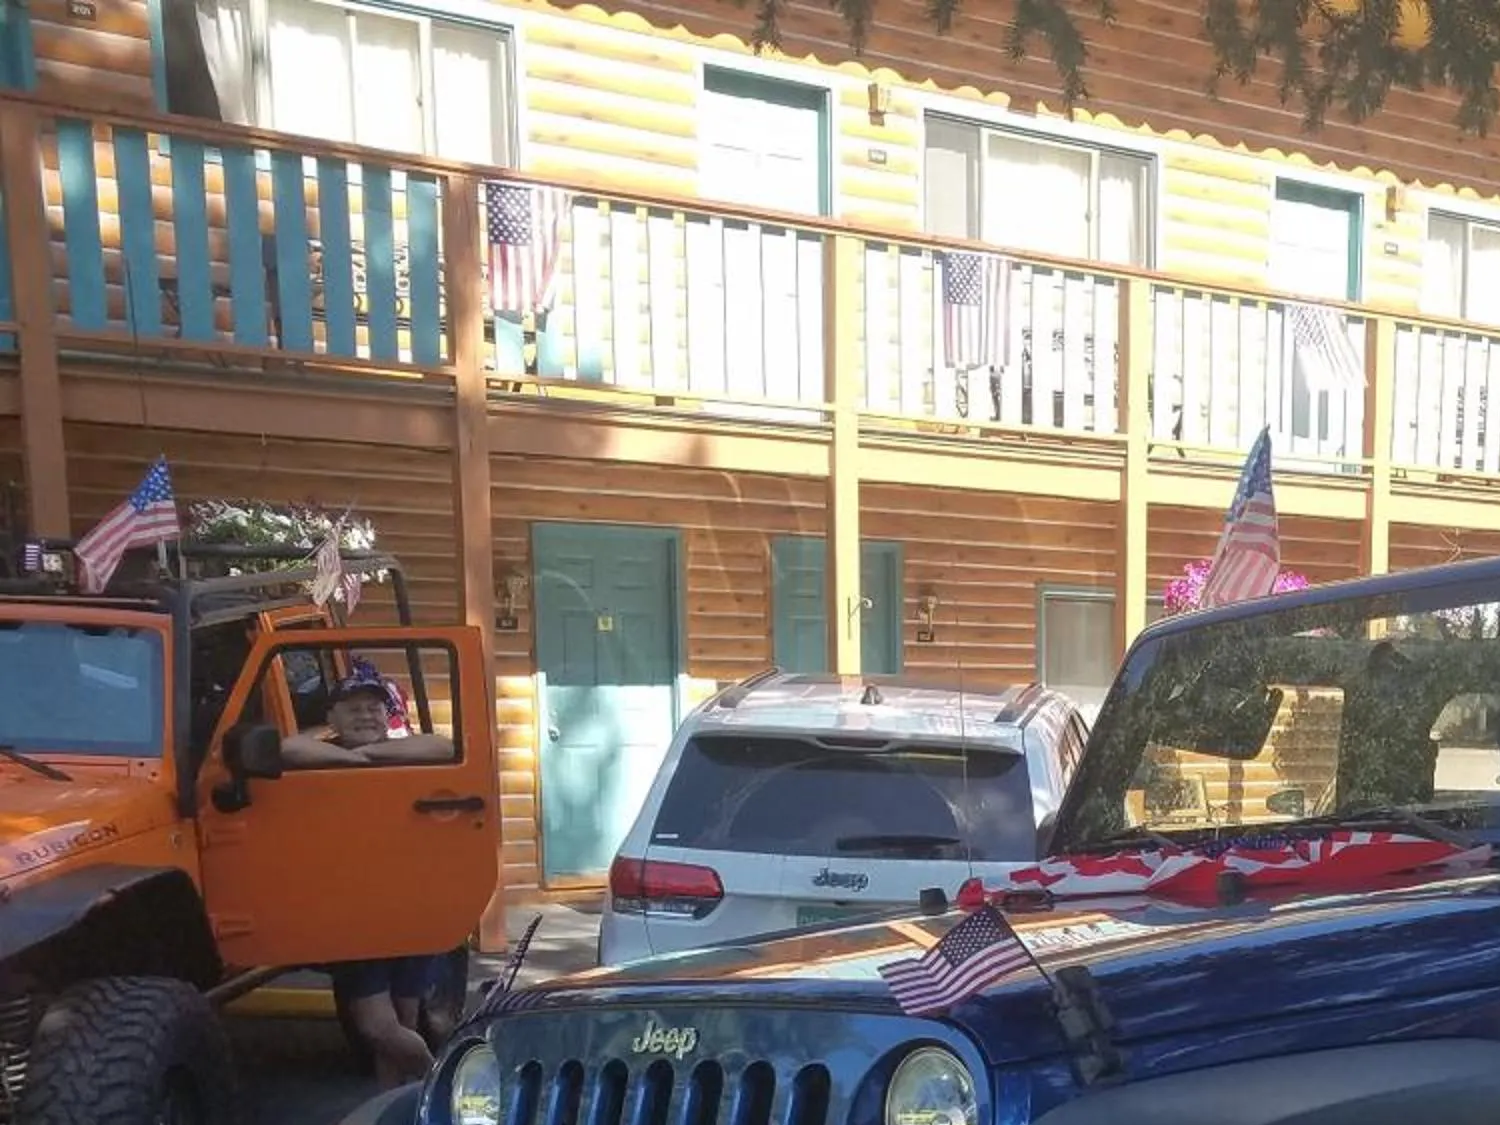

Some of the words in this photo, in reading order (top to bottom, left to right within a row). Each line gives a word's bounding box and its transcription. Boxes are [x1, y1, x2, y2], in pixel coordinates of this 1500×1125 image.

[15, 823, 119, 866] RUBICON
[812, 867, 870, 893] Jeep
[631, 1018, 698, 1061] Jeep
